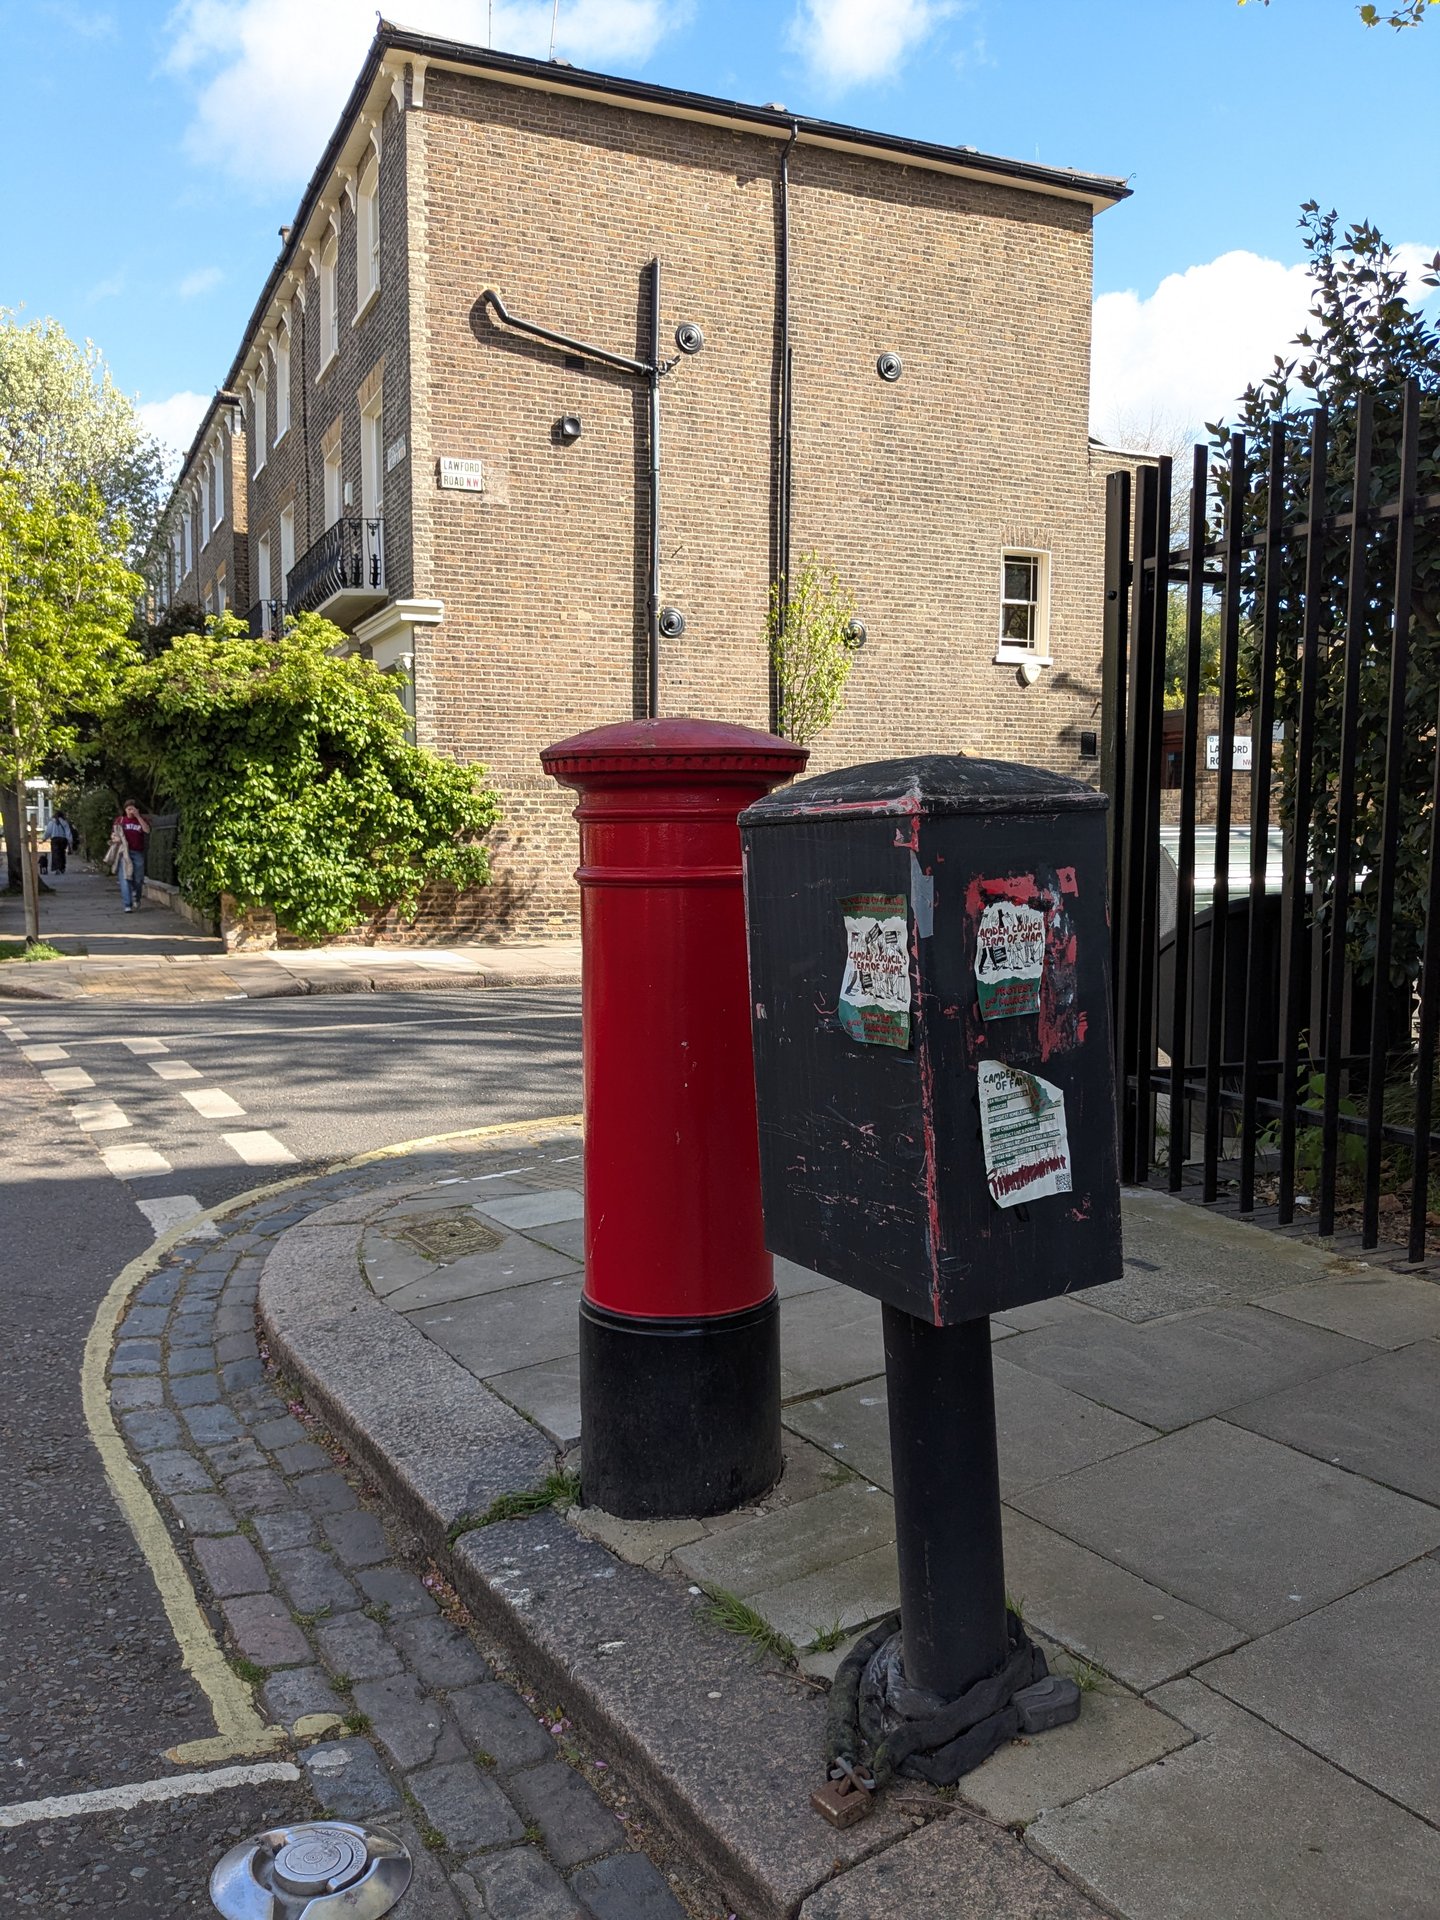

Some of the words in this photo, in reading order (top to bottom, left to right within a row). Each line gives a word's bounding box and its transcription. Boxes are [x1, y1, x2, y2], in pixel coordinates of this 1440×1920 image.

[443, 460, 480, 473] LAWFORD
[443, 475, 465, 487] ROAD
[1210, 745, 1249, 753] LAORD
[978, 926, 1009, 939] AMDEN
[1012, 922, 1041, 933] COUNCI
[981, 936, 1005, 947] TERM
[1007, 934, 1018, 945] OF
[1020, 931, 1044, 944] SHAM
[849, 951, 874, 962] CAMDEN
[854, 961, 870, 972] TERM
[870, 962, 880, 972] OF
[881, 963, 903, 976] SHAME
[983, 1069, 1015, 1083] CAMDEN
[996, 1080, 1007, 1091] OF
[1009, 1077, 1023, 1089] FAI
